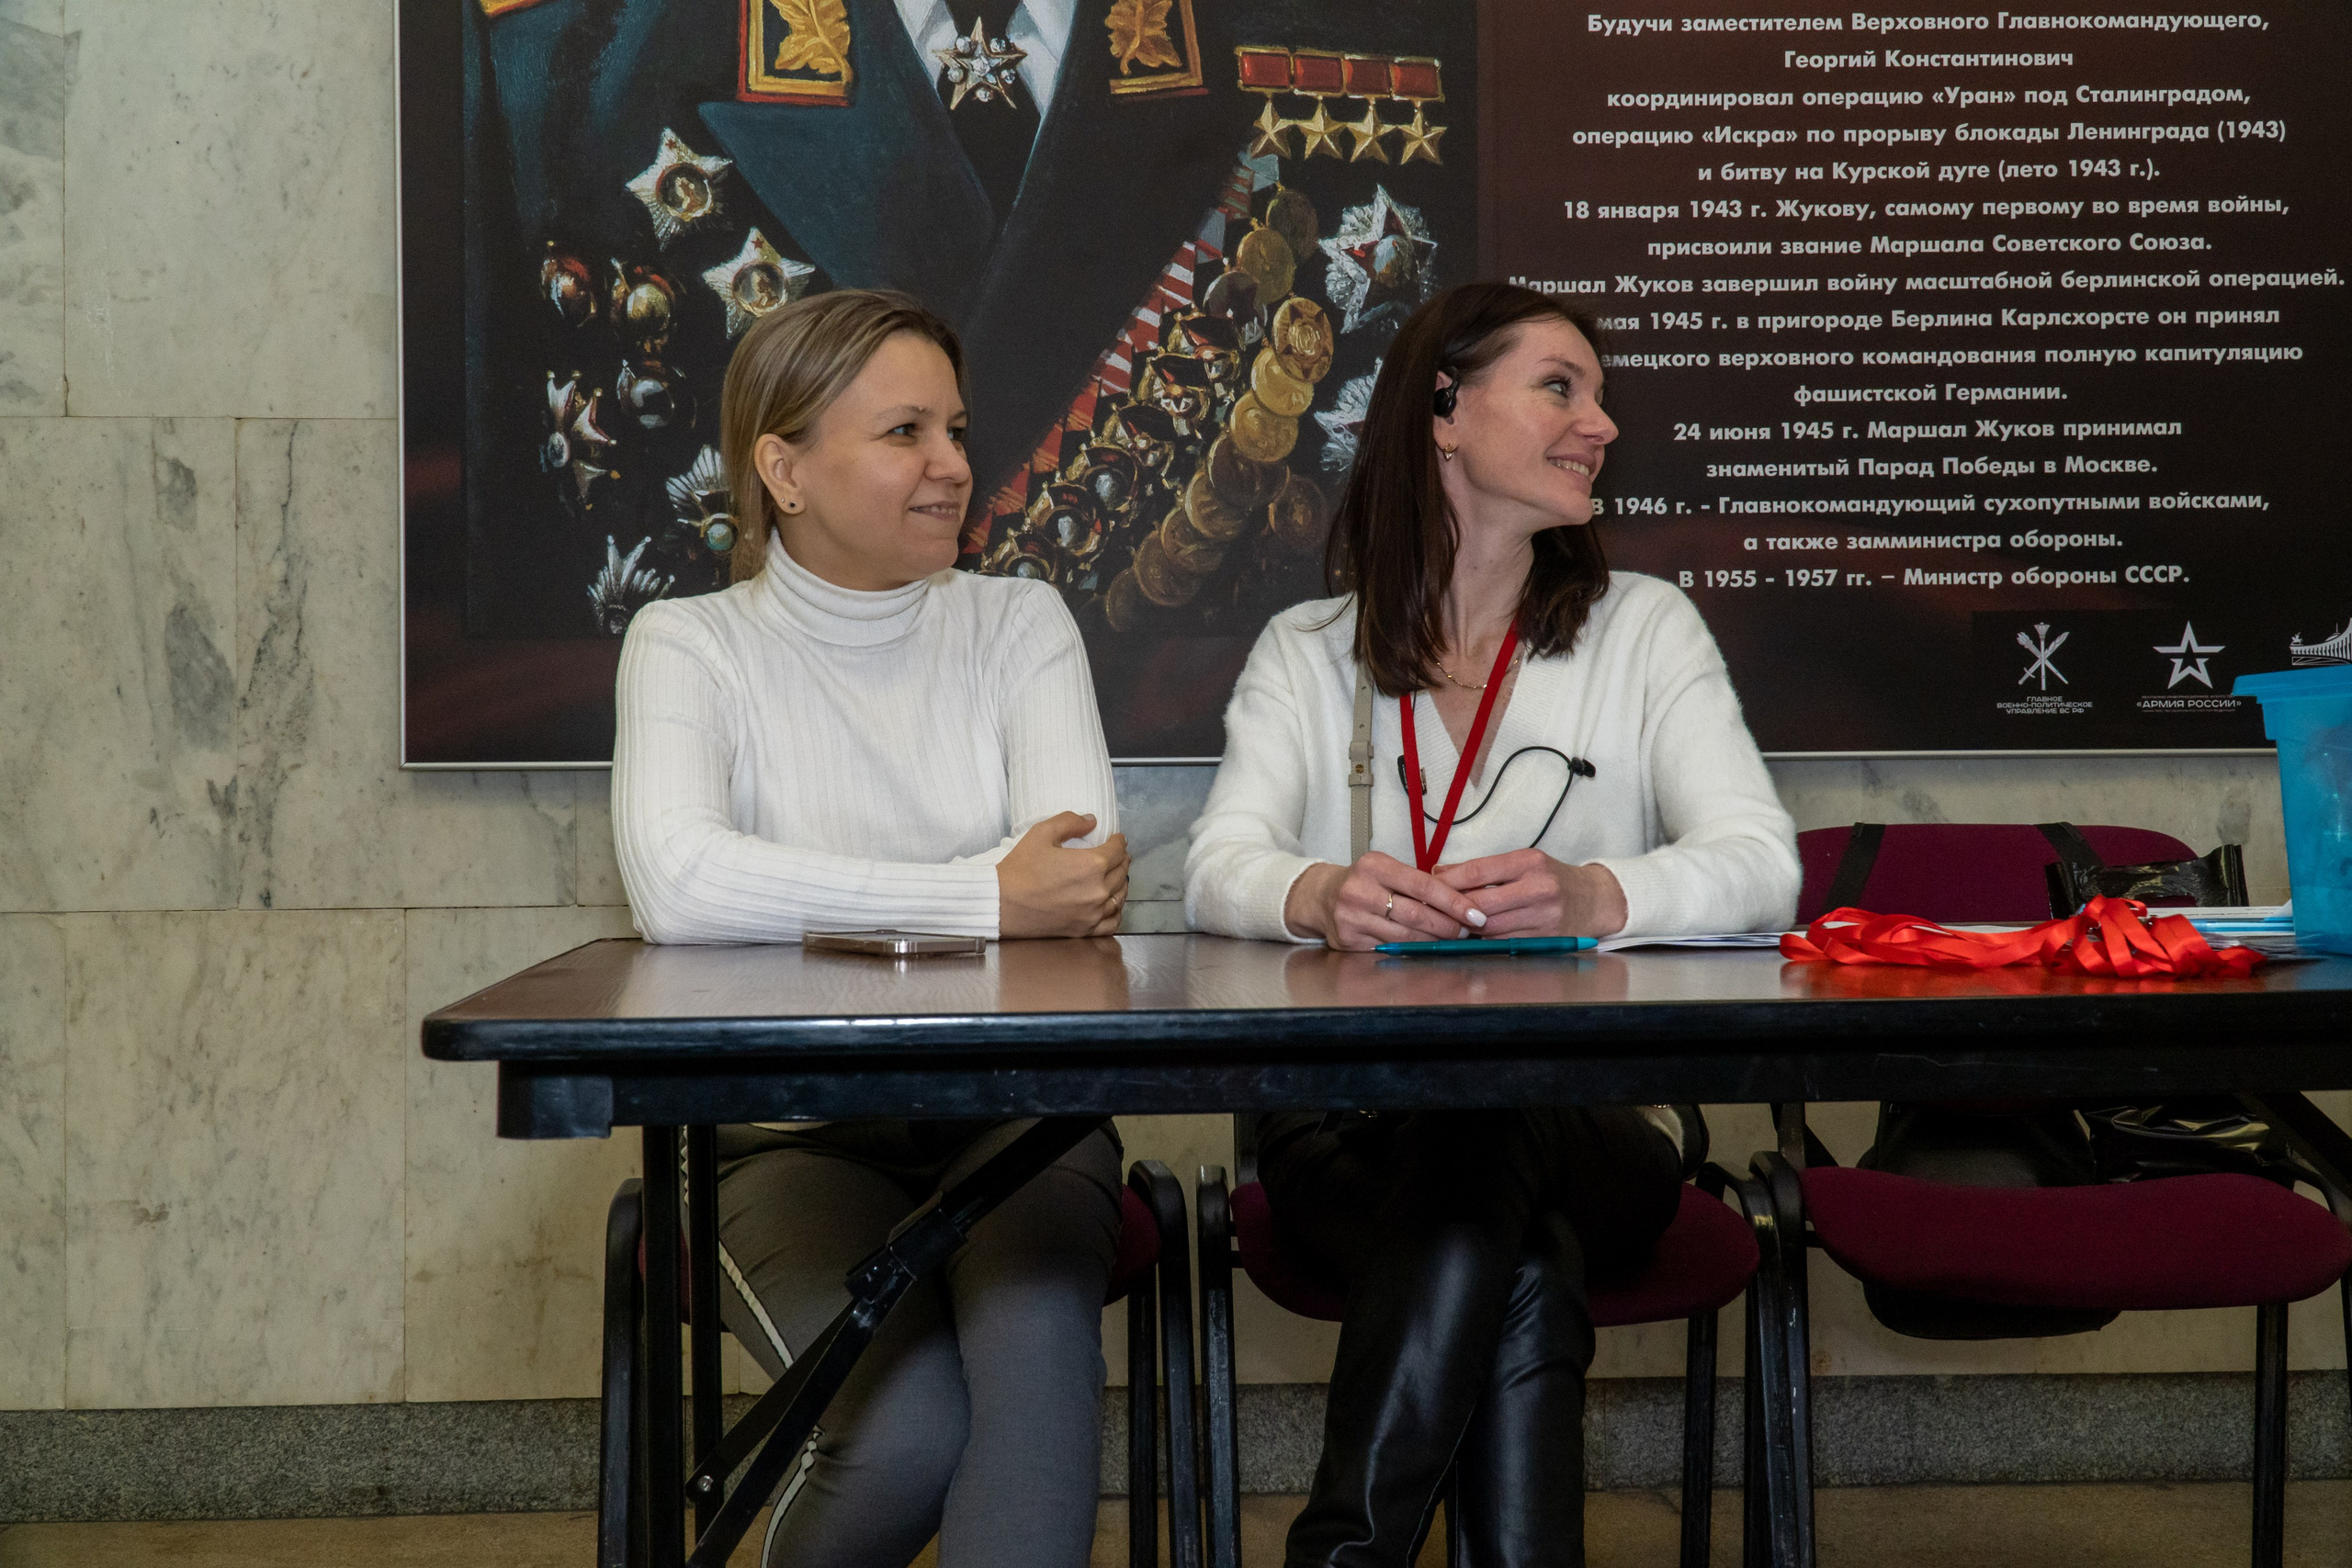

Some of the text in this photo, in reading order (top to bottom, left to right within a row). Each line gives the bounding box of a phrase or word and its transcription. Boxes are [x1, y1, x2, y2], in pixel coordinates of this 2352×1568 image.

[1588, 11, 2269, 37] Будучи заместителем Верховного Главнокомандующего,
[1784, 50, 2074, 73] Георгий Константинович
[1607, 85, 2251, 111] координировал операцию «Уран» под Сталинградом,
[1572, 119, 2286, 149] операцию «Искра» по прорыву блокады Ленинграда (1943)
[1698, 157, 2160, 185] и битву на Курской дуге (лето 1943 г.).
[1564, 195, 2290, 223] 18 января 1943 г. Жукову, самому первому во время войны,
[1647, 232, 2212, 260] присвоили звание Маршала Советского Союза.
[1509, 268, 2345, 298] Маршал Жуков завершил войну масштабной берлинской операцией.
[1598, 309, 2279, 333] мая 1945 г. в пригороде Берлина Карлсхорсте он принял
[1600, 346, 2303, 371] емецкого верховного командования полную капитуляцию
[1793, 383, 2067, 407] фашистской Германии.
[1673, 420, 2182, 443] 24 июня 1945 г. Маршал Жуков принимал
[1706, 456, 2157, 479] знаменитый Парад Победы в Москве.
[1589, 497, 1605, 515] В
[1614, 497, 1668, 515] 1946
[1676, 502, 1692, 514] г.
[1719, 494, 1975, 516] Главнокомандующий
[1984, 496, 2140, 515] сухопутными
[2149, 491, 2269, 511] войсками,
[1743, 529, 2123, 553] а также замминистра обороны.
[1679, 570, 1694, 588] В
[1704, 570, 1757, 588] 1955
[1785, 569, 1838, 587] 1957
[1847, 573, 1871, 586] гг.
[1903, 568, 2003, 590] Министр
[2011, 566, 2117, 589] обороны
[2125, 565, 2189, 583] СССР.
[1996, 701, 2093, 709] ВОЕННО-ПОЛИТИЧЕСКОЕ
[2136, 699, 2242, 708] «АРМИЯ РОССИИ»
